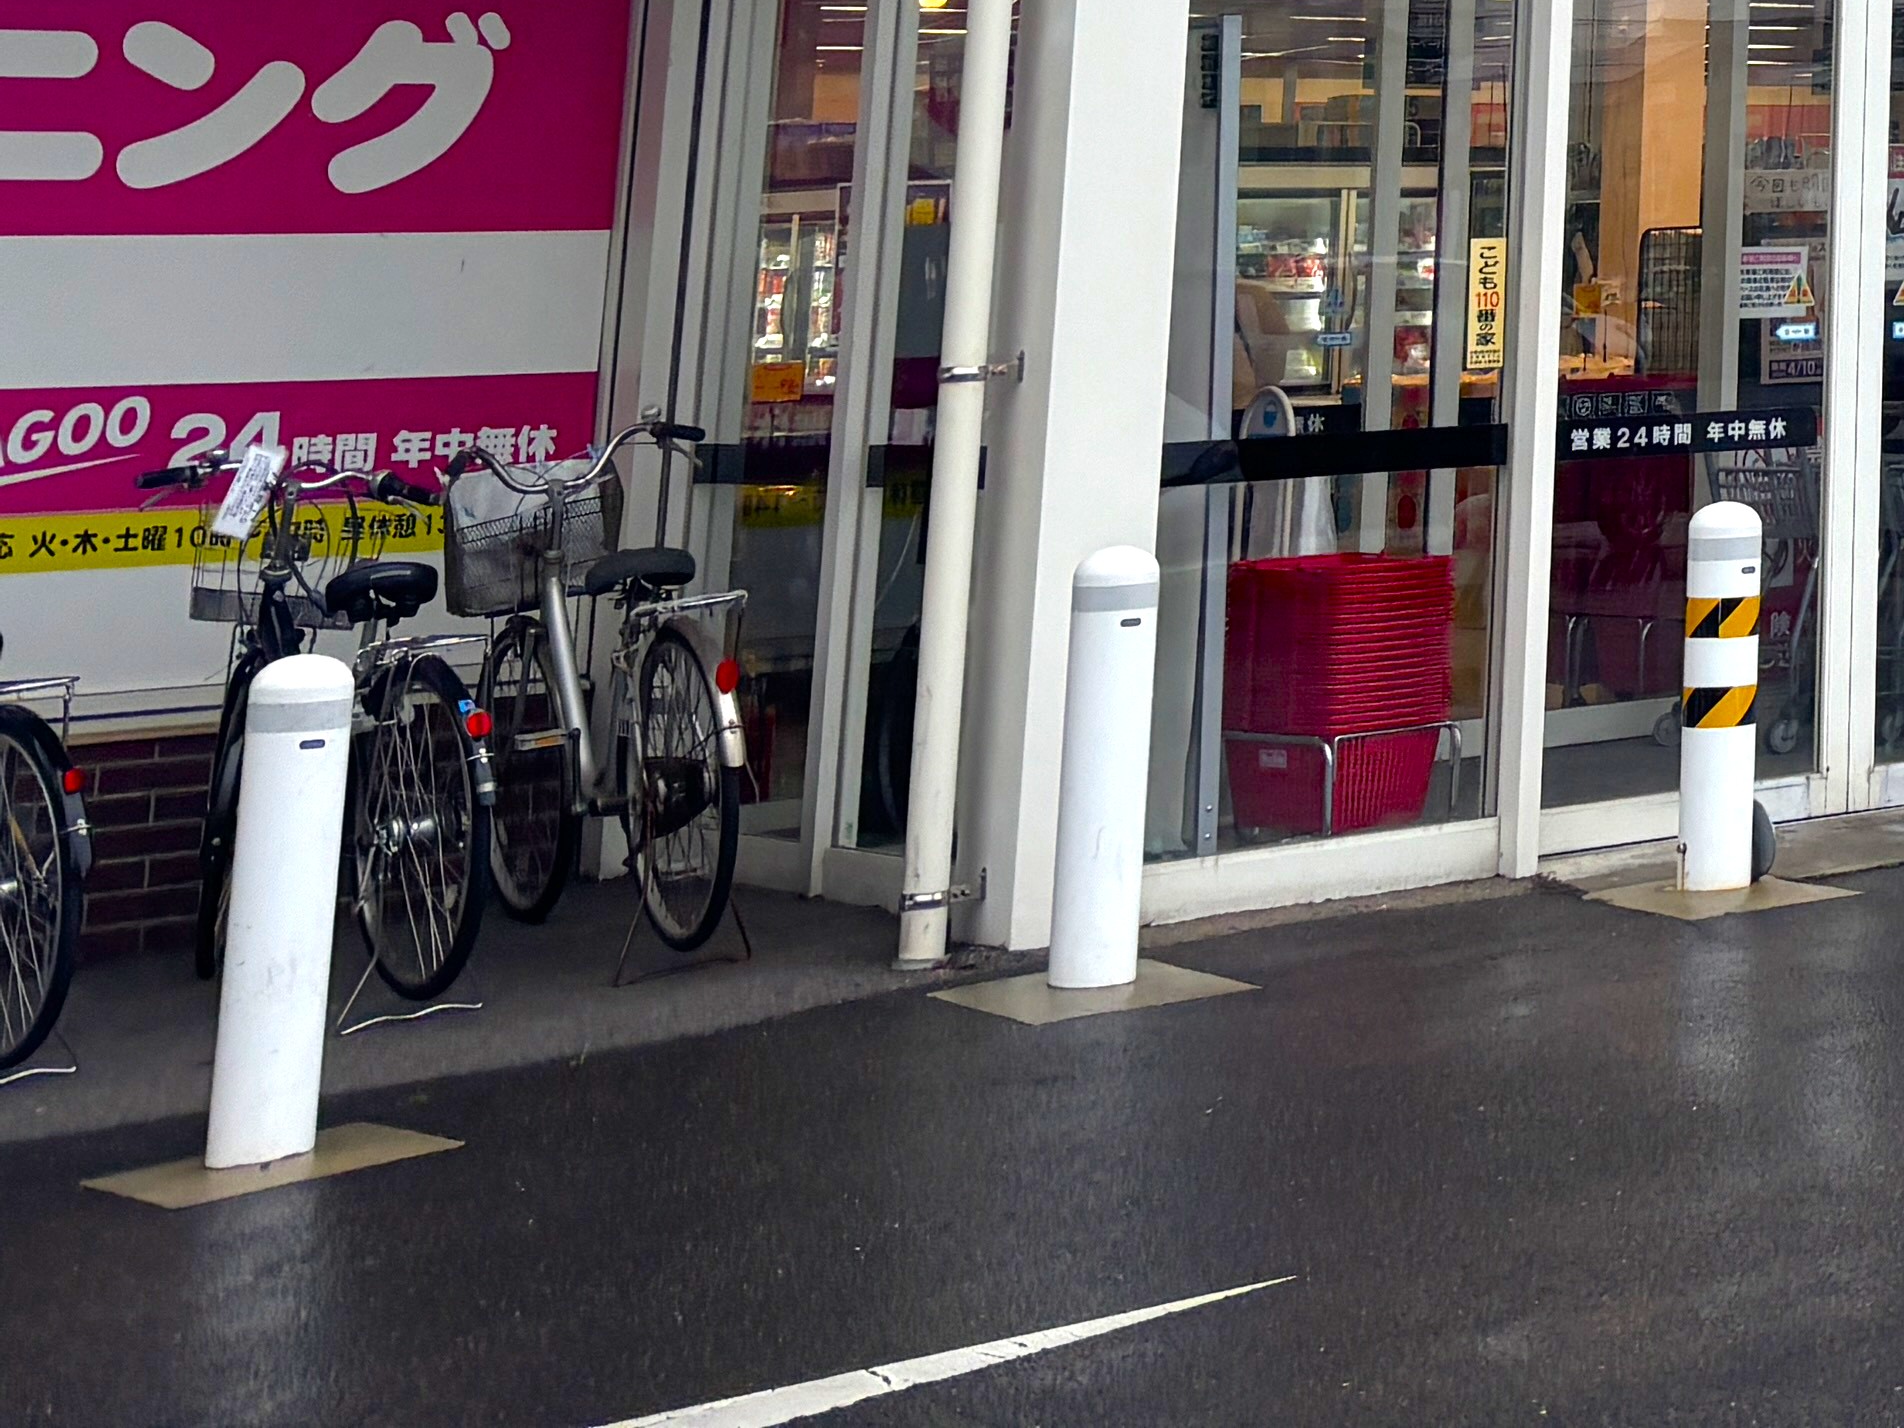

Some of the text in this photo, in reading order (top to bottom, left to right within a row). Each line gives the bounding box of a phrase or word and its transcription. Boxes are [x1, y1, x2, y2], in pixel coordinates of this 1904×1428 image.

[1474, 245, 1500, 347] こども110番の家
[0, 395, 151, 469] GOO
[390, 424, 558, 469] 年中無休
[1571, 417, 1788, 451] 営業24時間 年中無休
